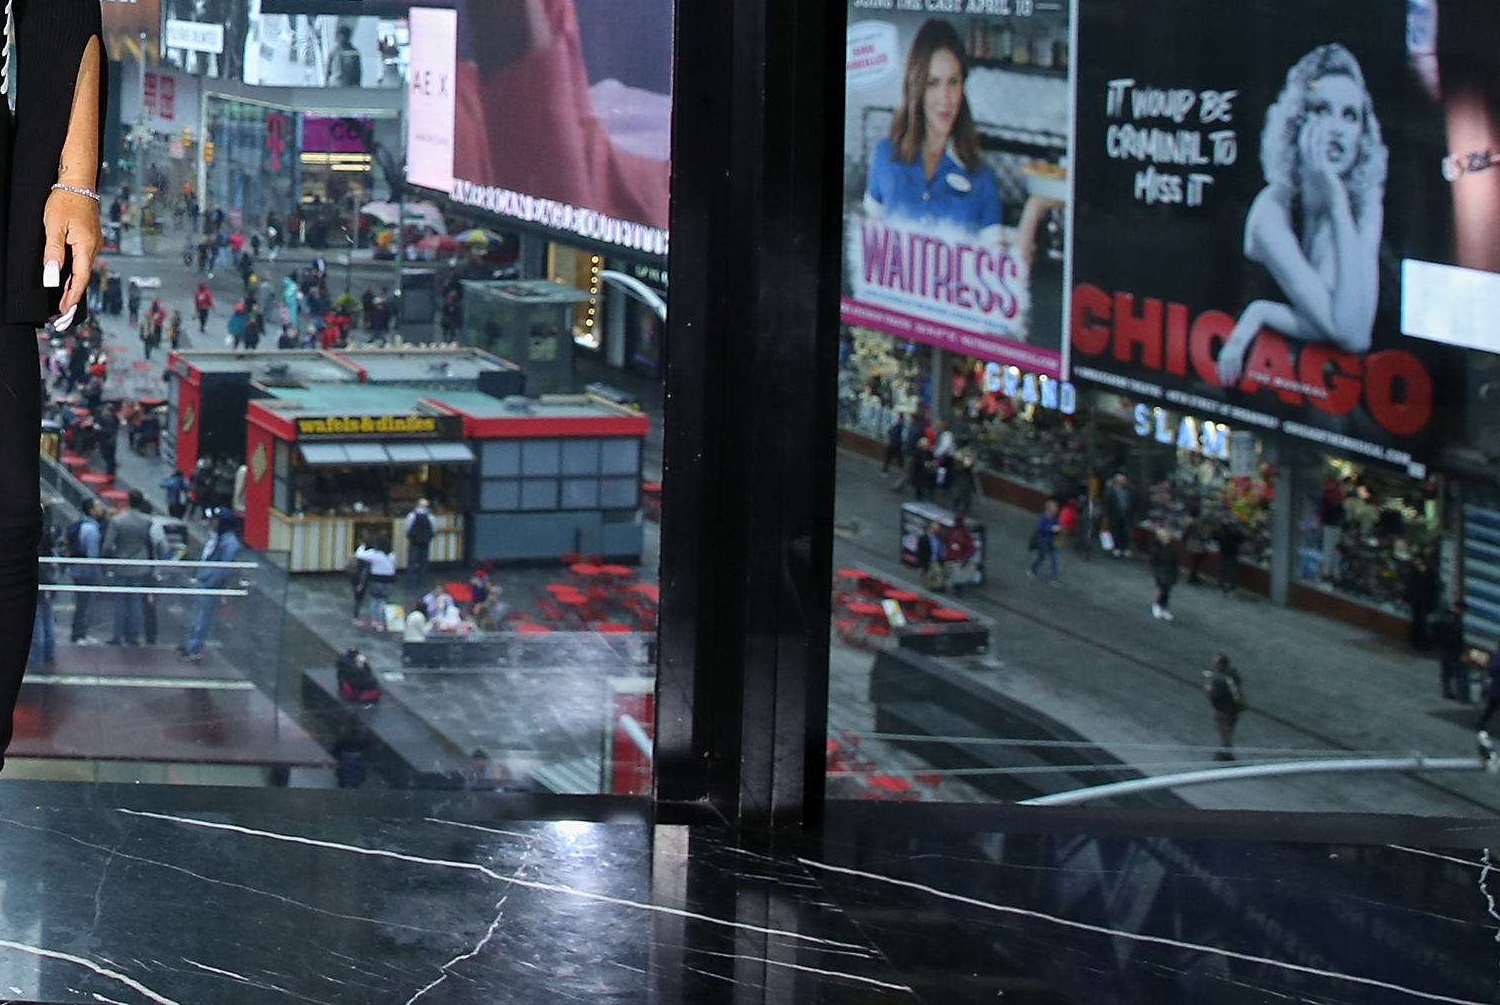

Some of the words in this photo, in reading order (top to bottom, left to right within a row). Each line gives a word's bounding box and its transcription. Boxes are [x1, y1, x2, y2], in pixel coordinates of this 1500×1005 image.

[1106, 78, 1136, 118] IT
[1130, 87, 1197, 123] WOULD
[1199, 89, 1240, 124] BE
[1106, 122, 1210, 166] CRIMINAL
[1207, 129, 1238, 166] TO
[1133, 165, 1183, 205] MISS
[1186, 173, 1215, 207] IT
[860, 221, 1019, 319] WAITRESS
[1071, 282, 1433, 436] CHICAGO
[985, 361, 1077, 415] GRAND
